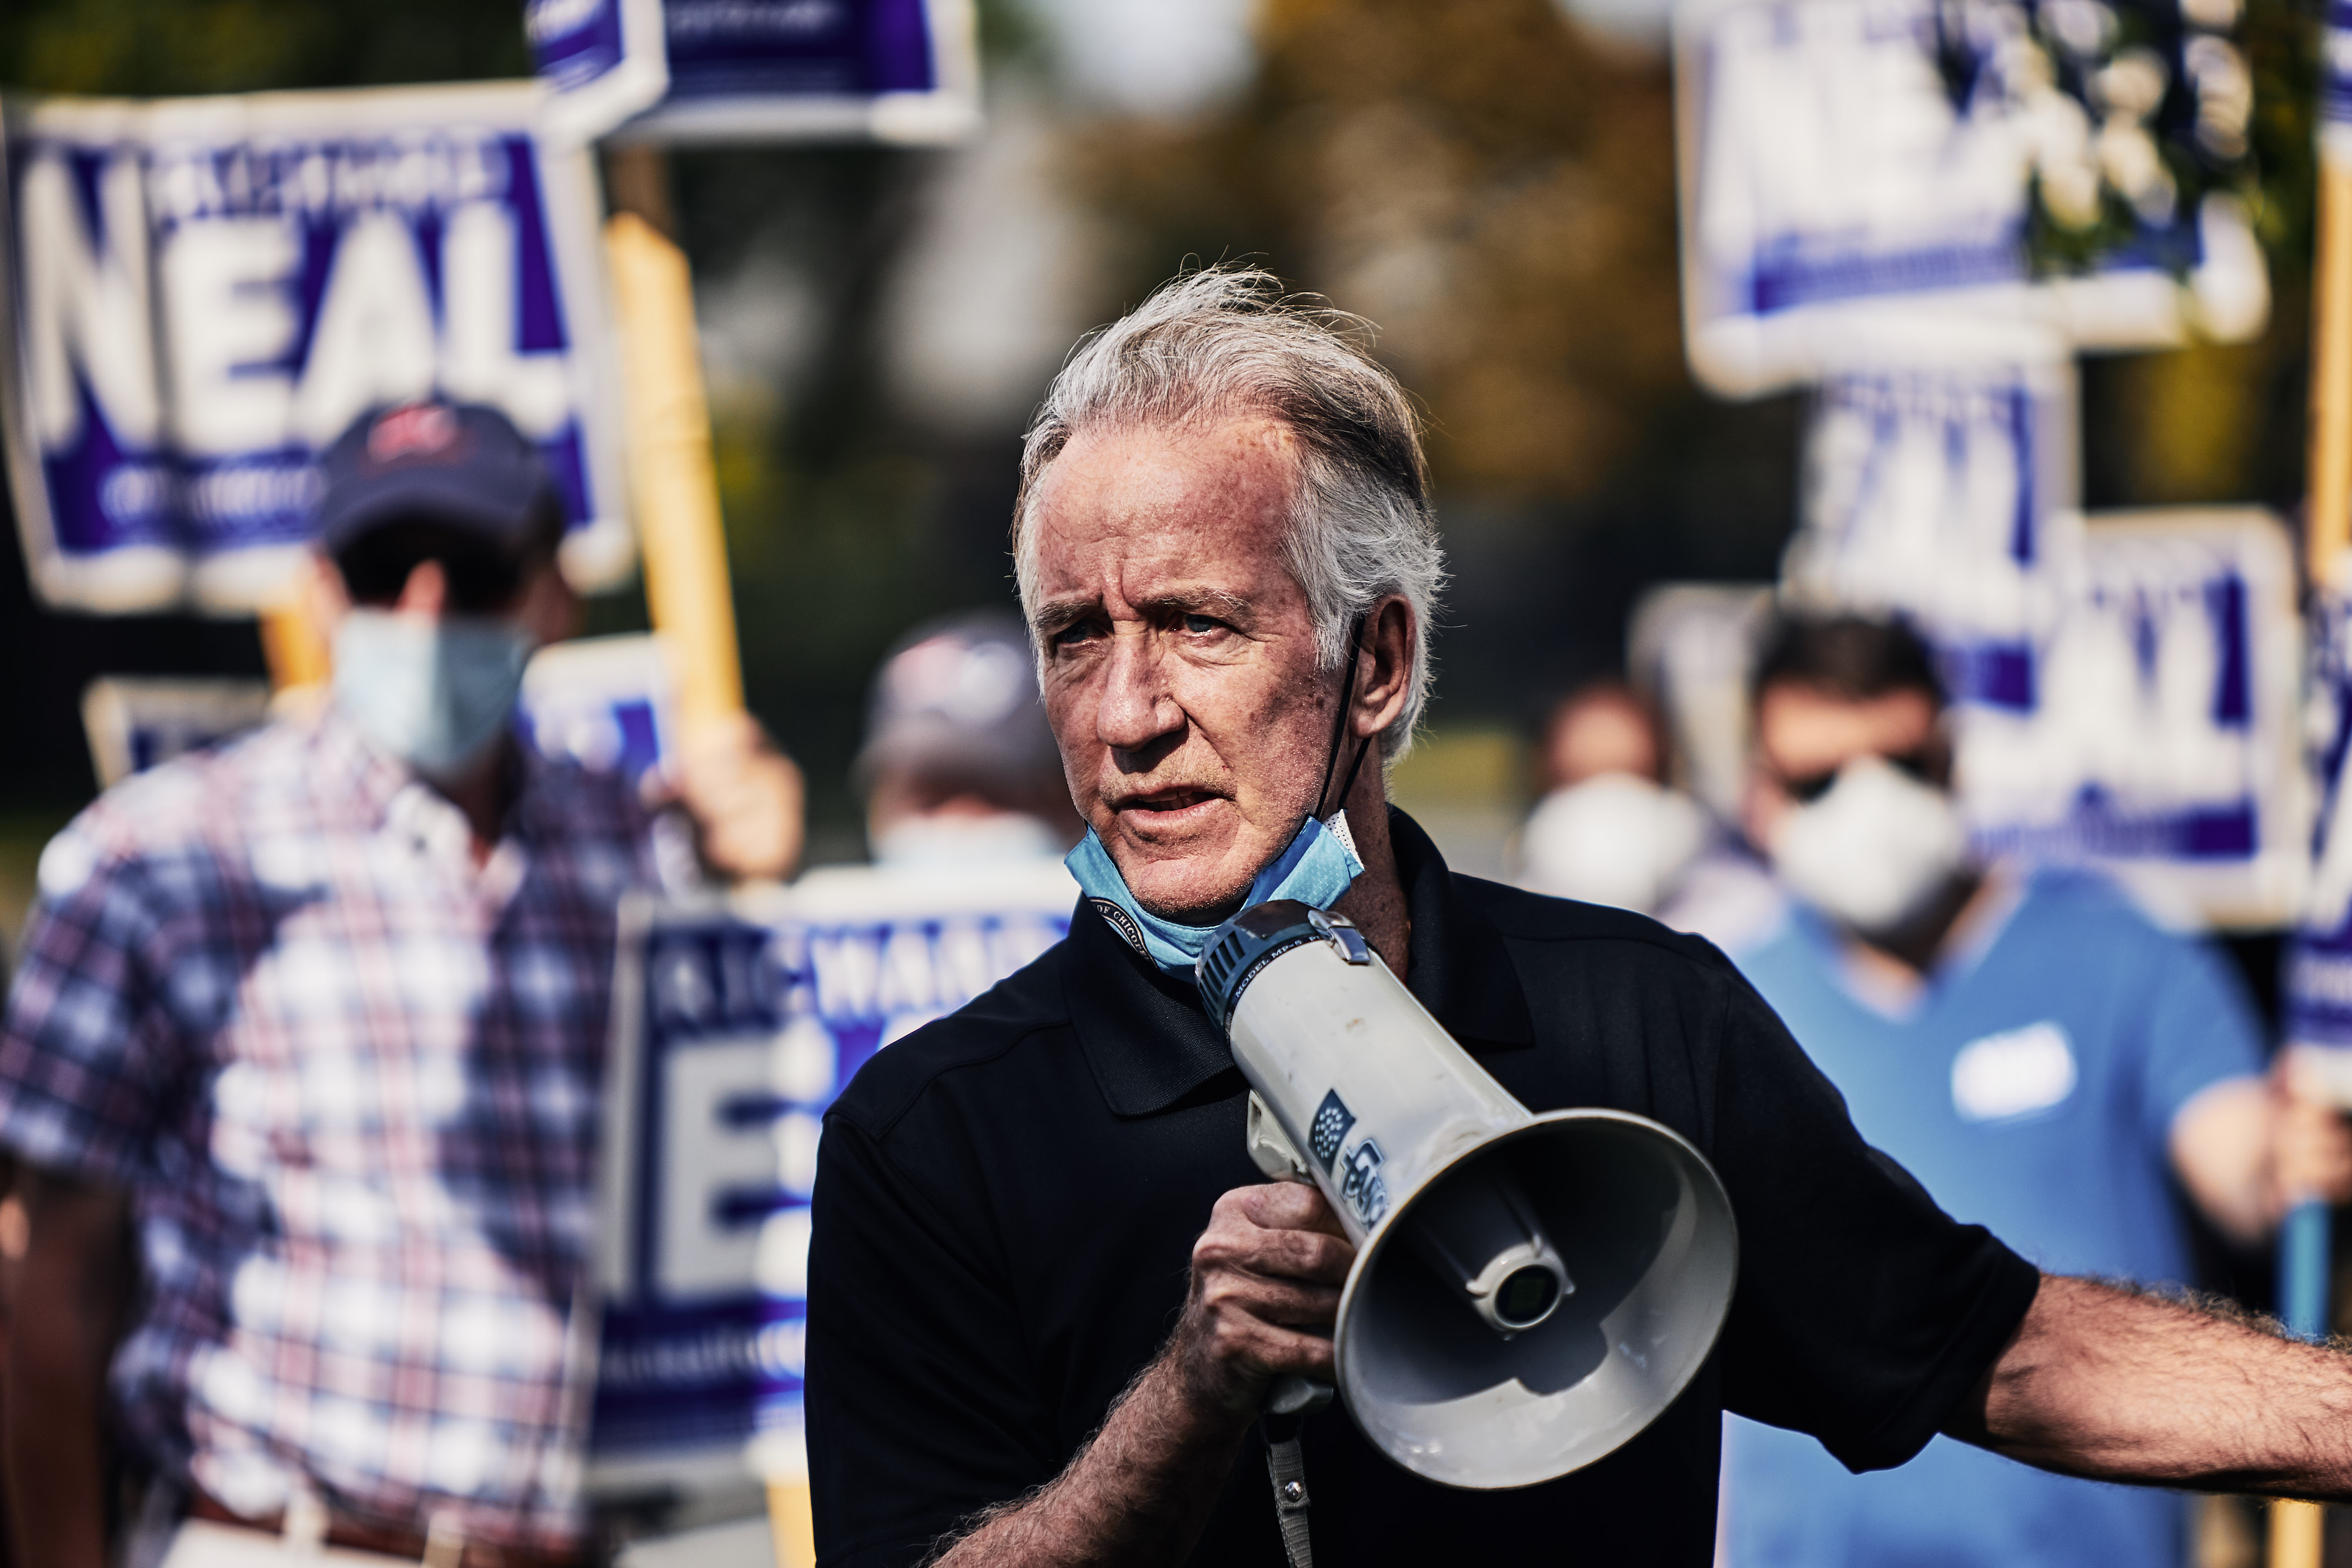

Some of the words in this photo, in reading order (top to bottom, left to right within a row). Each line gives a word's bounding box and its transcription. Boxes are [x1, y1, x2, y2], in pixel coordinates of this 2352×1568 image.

[22, 152, 569, 459] NEAL
[1096, 904, 1111, 915] OF
[1112, 911, 1150, 961] CHICOPE
[1235, 959, 1269, 998] MODEL
